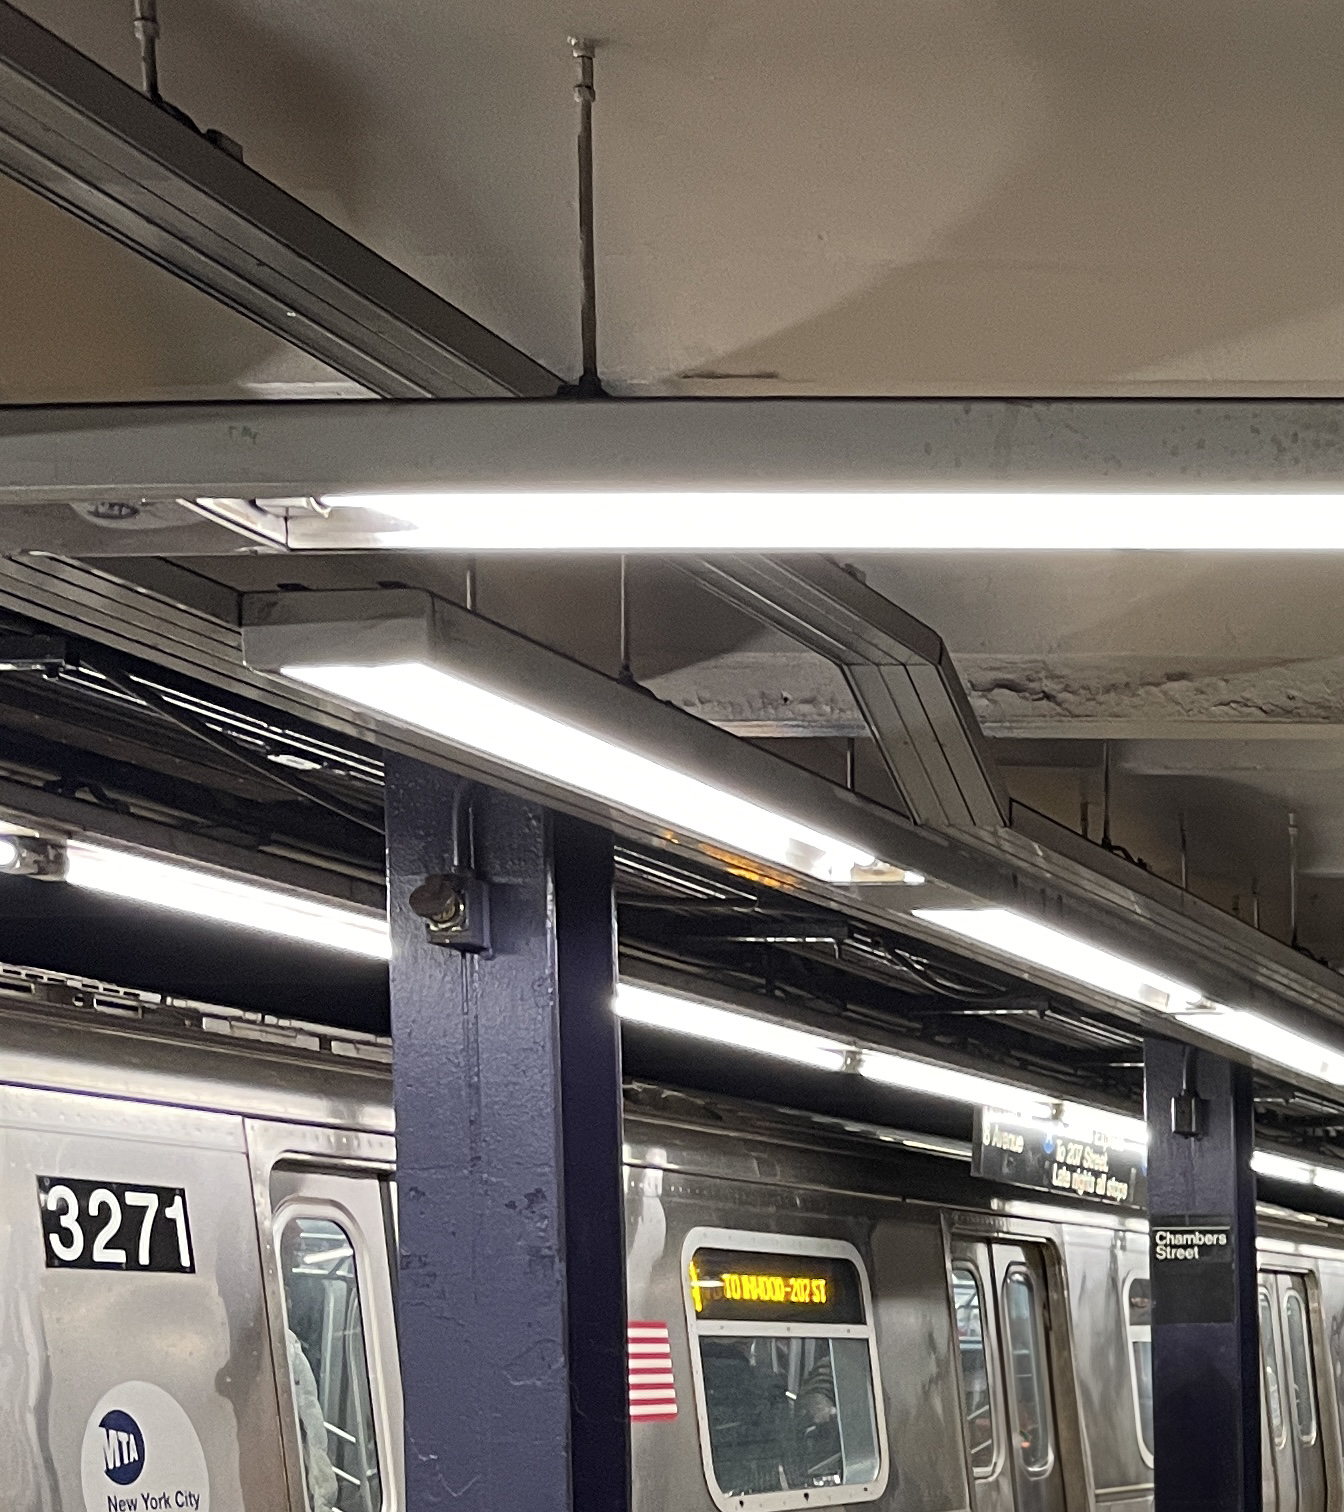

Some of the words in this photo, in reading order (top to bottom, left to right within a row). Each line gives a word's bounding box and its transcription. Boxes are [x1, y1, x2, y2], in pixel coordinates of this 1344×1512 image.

[992, 1125, 1024, 1153] Avenue
[1055, 1139, 1066, 1162] To
[1066, 1143, 1083, 1166] 207
[1083, 1146, 1108, 1172] Street
[1052, 1163, 1071, 1188] Late
[1072, 1167, 1095, 1195] nights
[1096, 1173, 1107, 1195] all
[1107, 1177, 1128, 1201] stops
[47, 1185, 191, 1267] 3271
[1155, 1231, 1227, 1245] Chambers
[1155, 1245, 1199, 1260] Street
[722, 1274, 741, 1299] TO
[811, 1278, 827, 1303] ST
[107, 1495, 138, 1512] New
[141, 1492, 172, 1511] York
[175, 1490, 200, 1511] City
